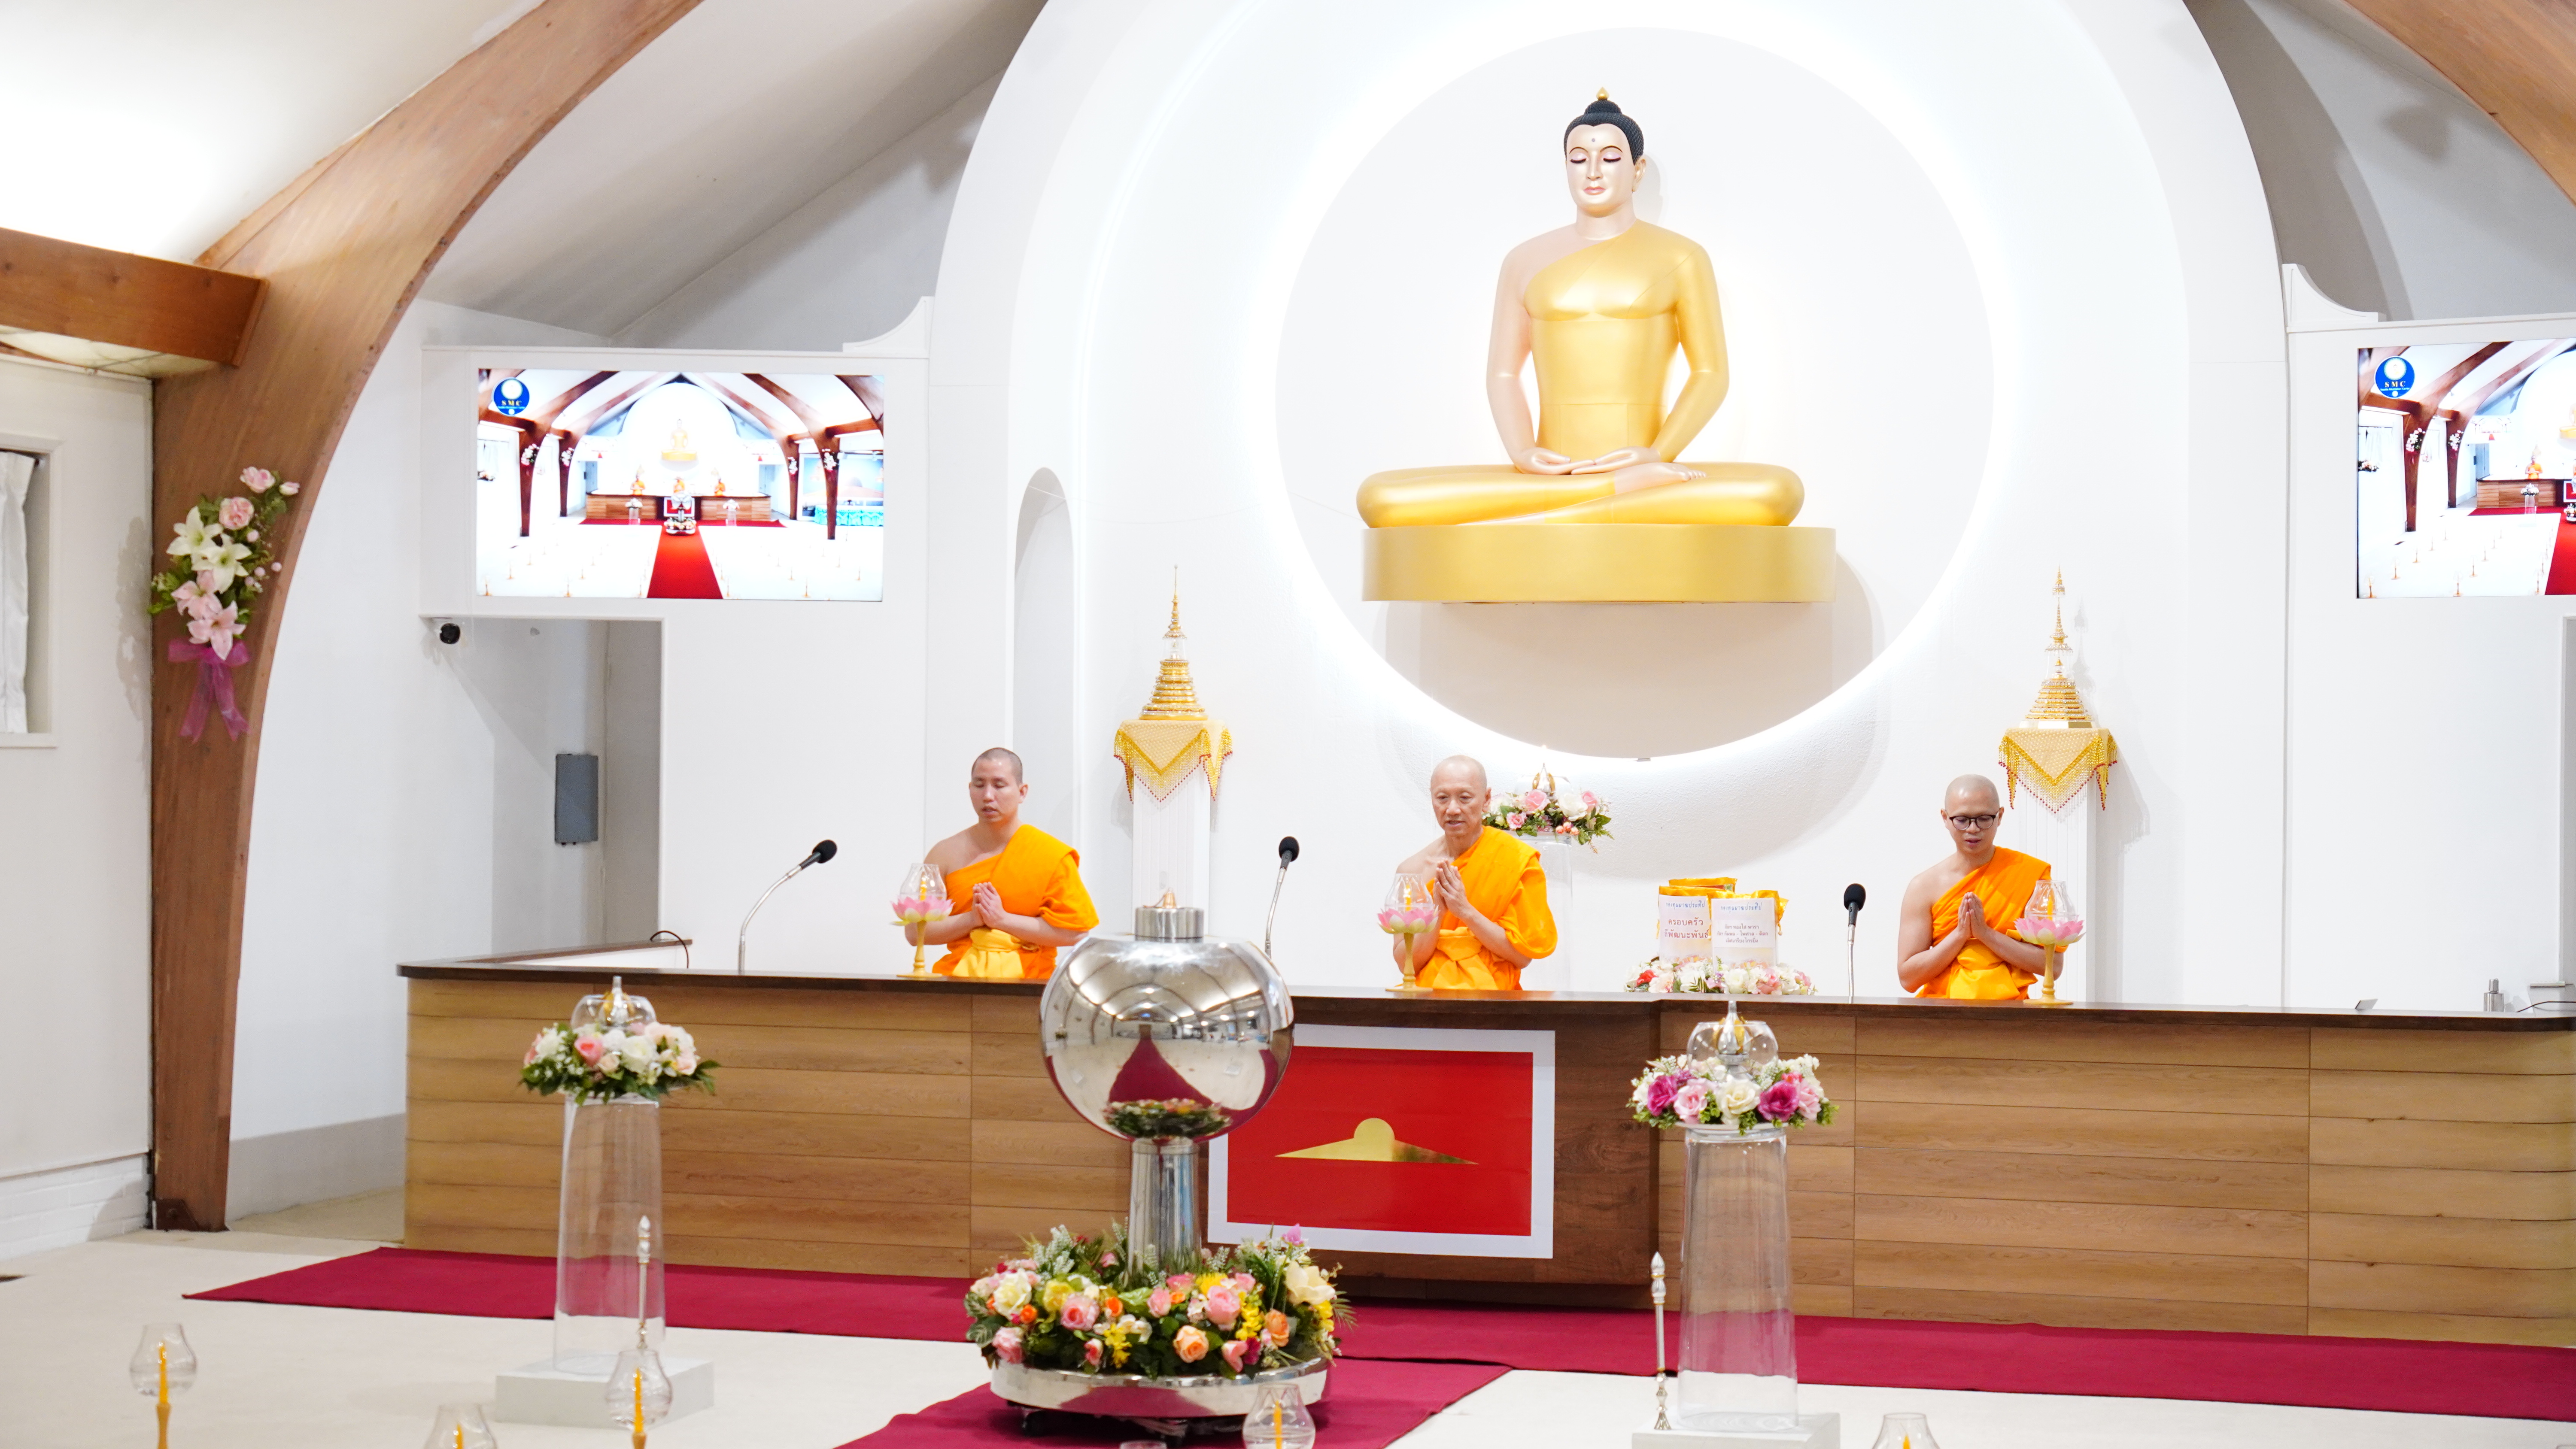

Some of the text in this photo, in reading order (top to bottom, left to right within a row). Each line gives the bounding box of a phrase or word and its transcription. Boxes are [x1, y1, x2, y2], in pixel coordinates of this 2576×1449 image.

[1668, 917, 1703, 925] ครอบครัว
[1665, 929, 1709, 938] ลีพัฒนะพันธ์
